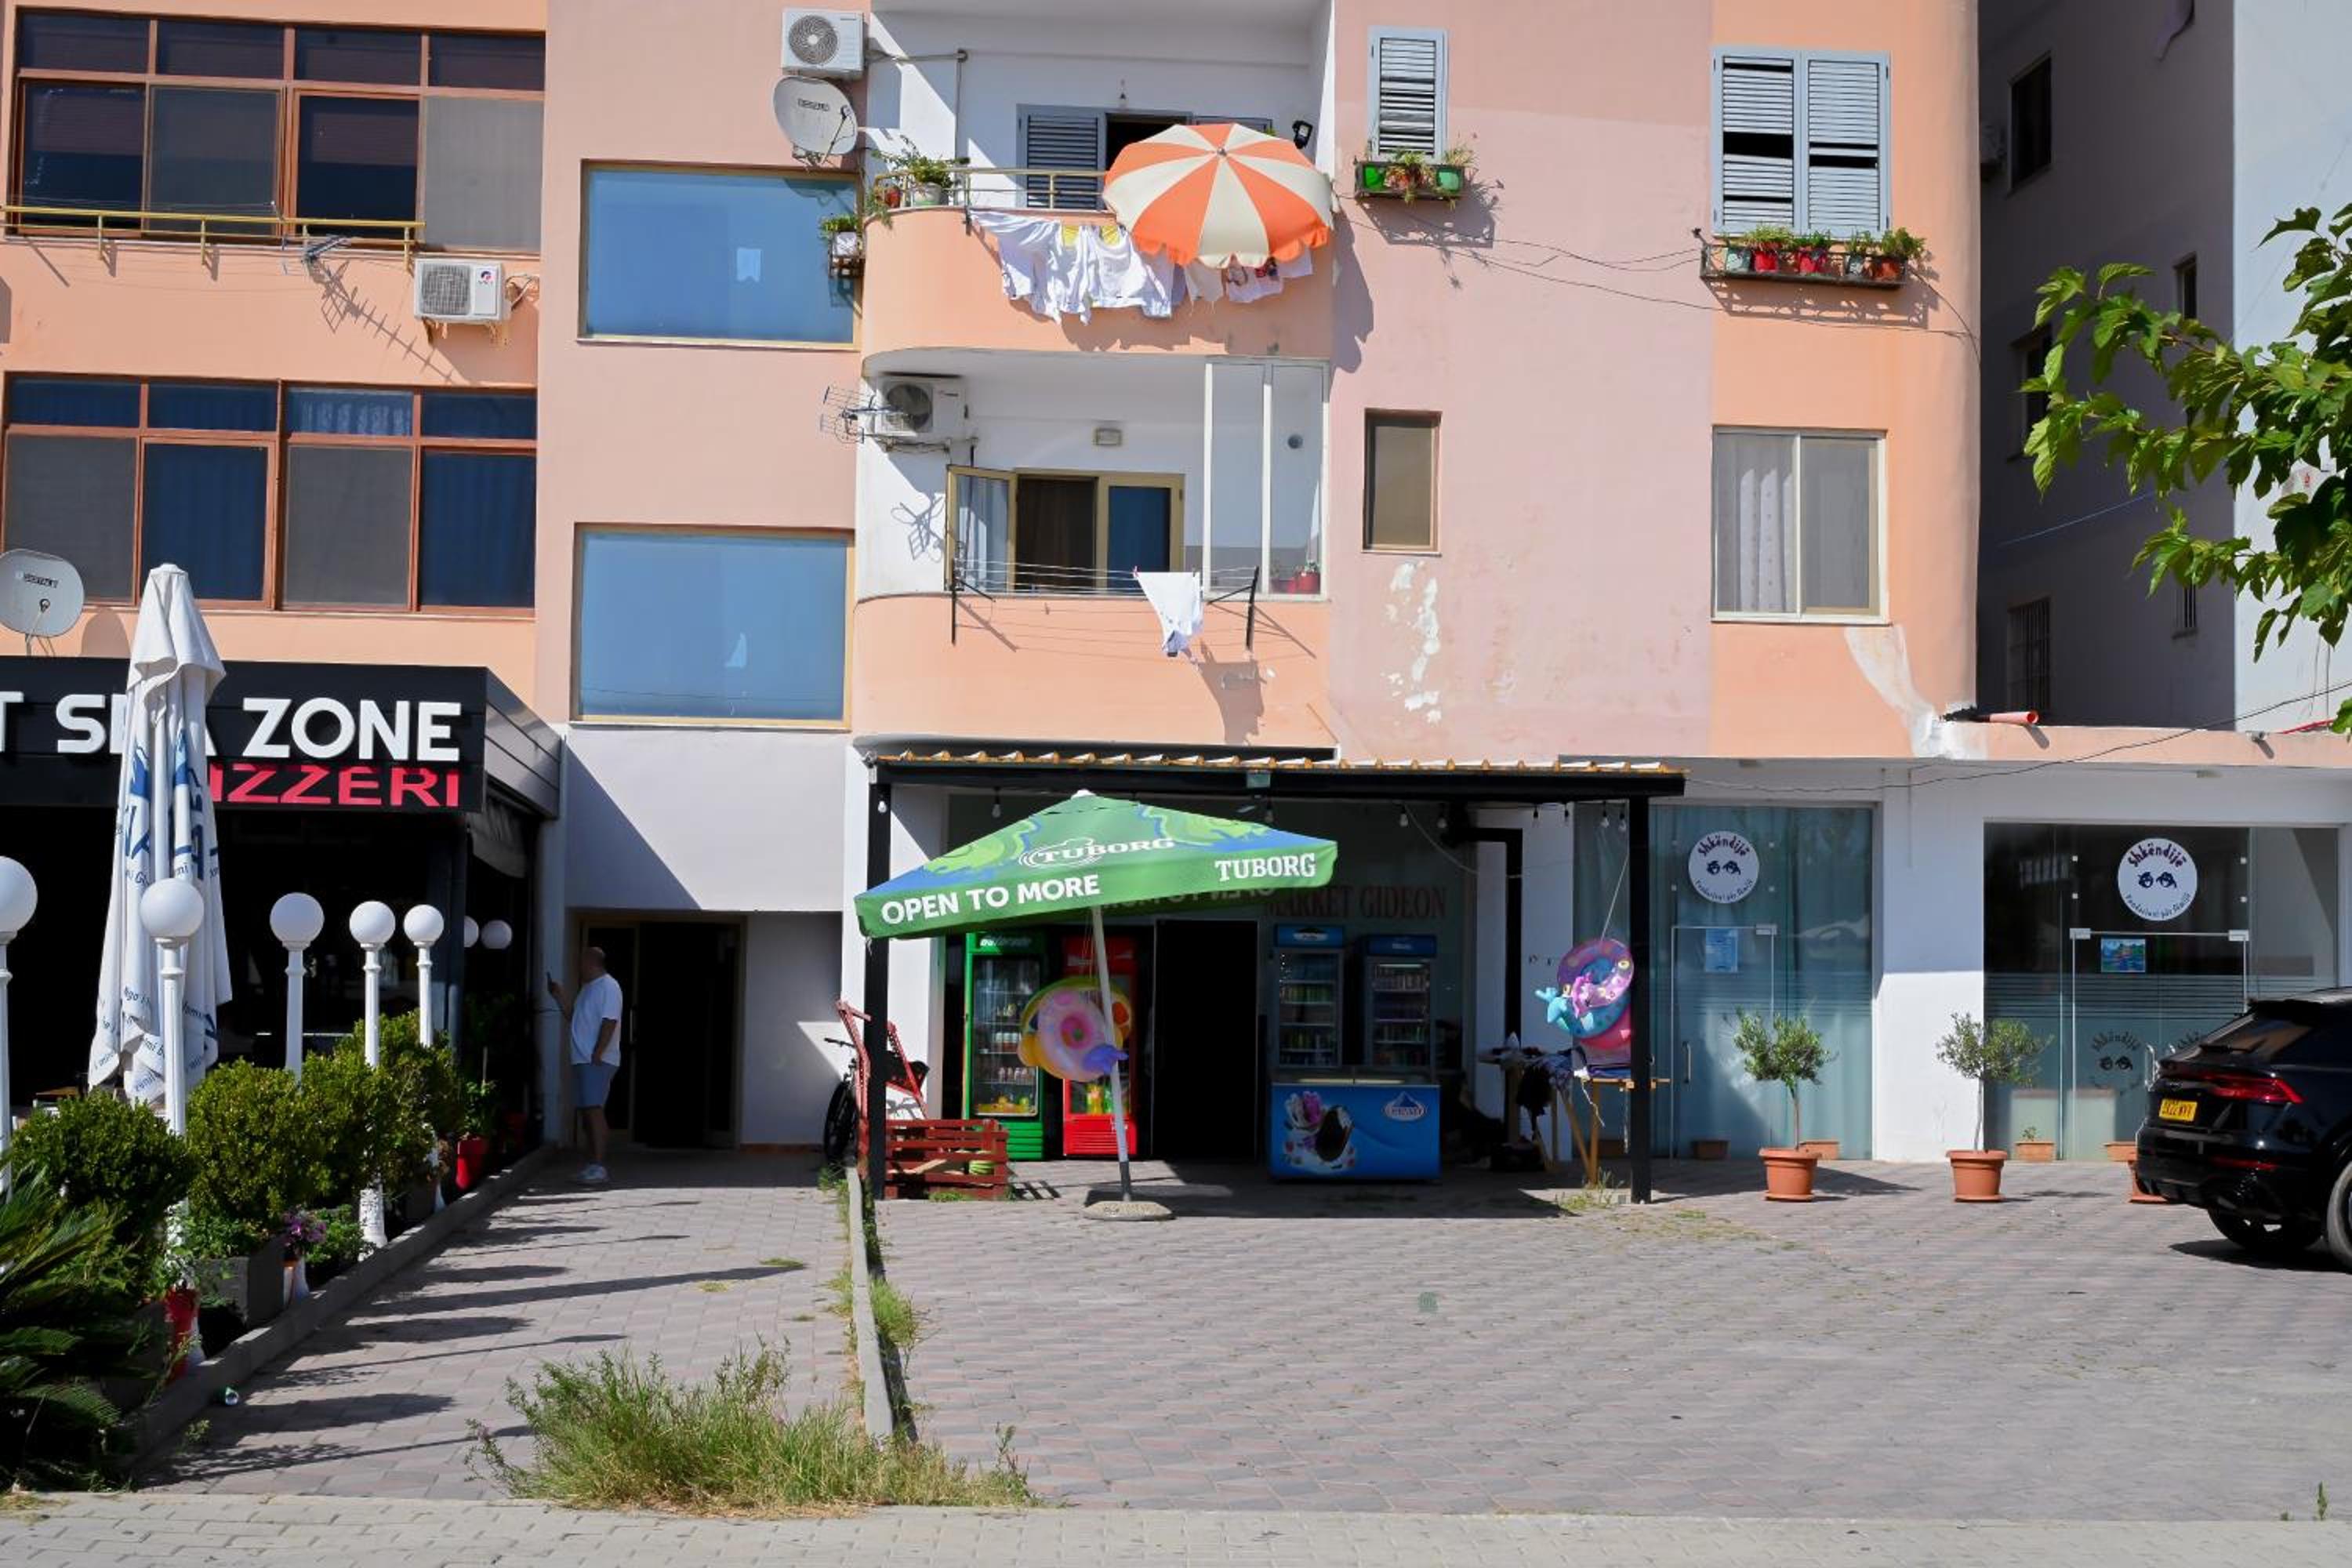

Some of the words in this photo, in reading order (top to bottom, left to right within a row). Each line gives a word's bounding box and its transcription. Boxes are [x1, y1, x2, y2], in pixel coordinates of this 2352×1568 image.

[242, 696, 462, 762] ZONE
[209, 762, 460, 808] IZZERI
[1037, 837, 1175, 862] TUBORG
[2127, 842, 2187, 868] Shkëndijë
[1214, 852, 1316, 882] TUBORG
[880, 891, 960, 925] OPEN
[965, 886, 1010, 911] TO
[1017, 874, 1101, 904] MORE
[1359, 885, 1448, 918] GIDEON
